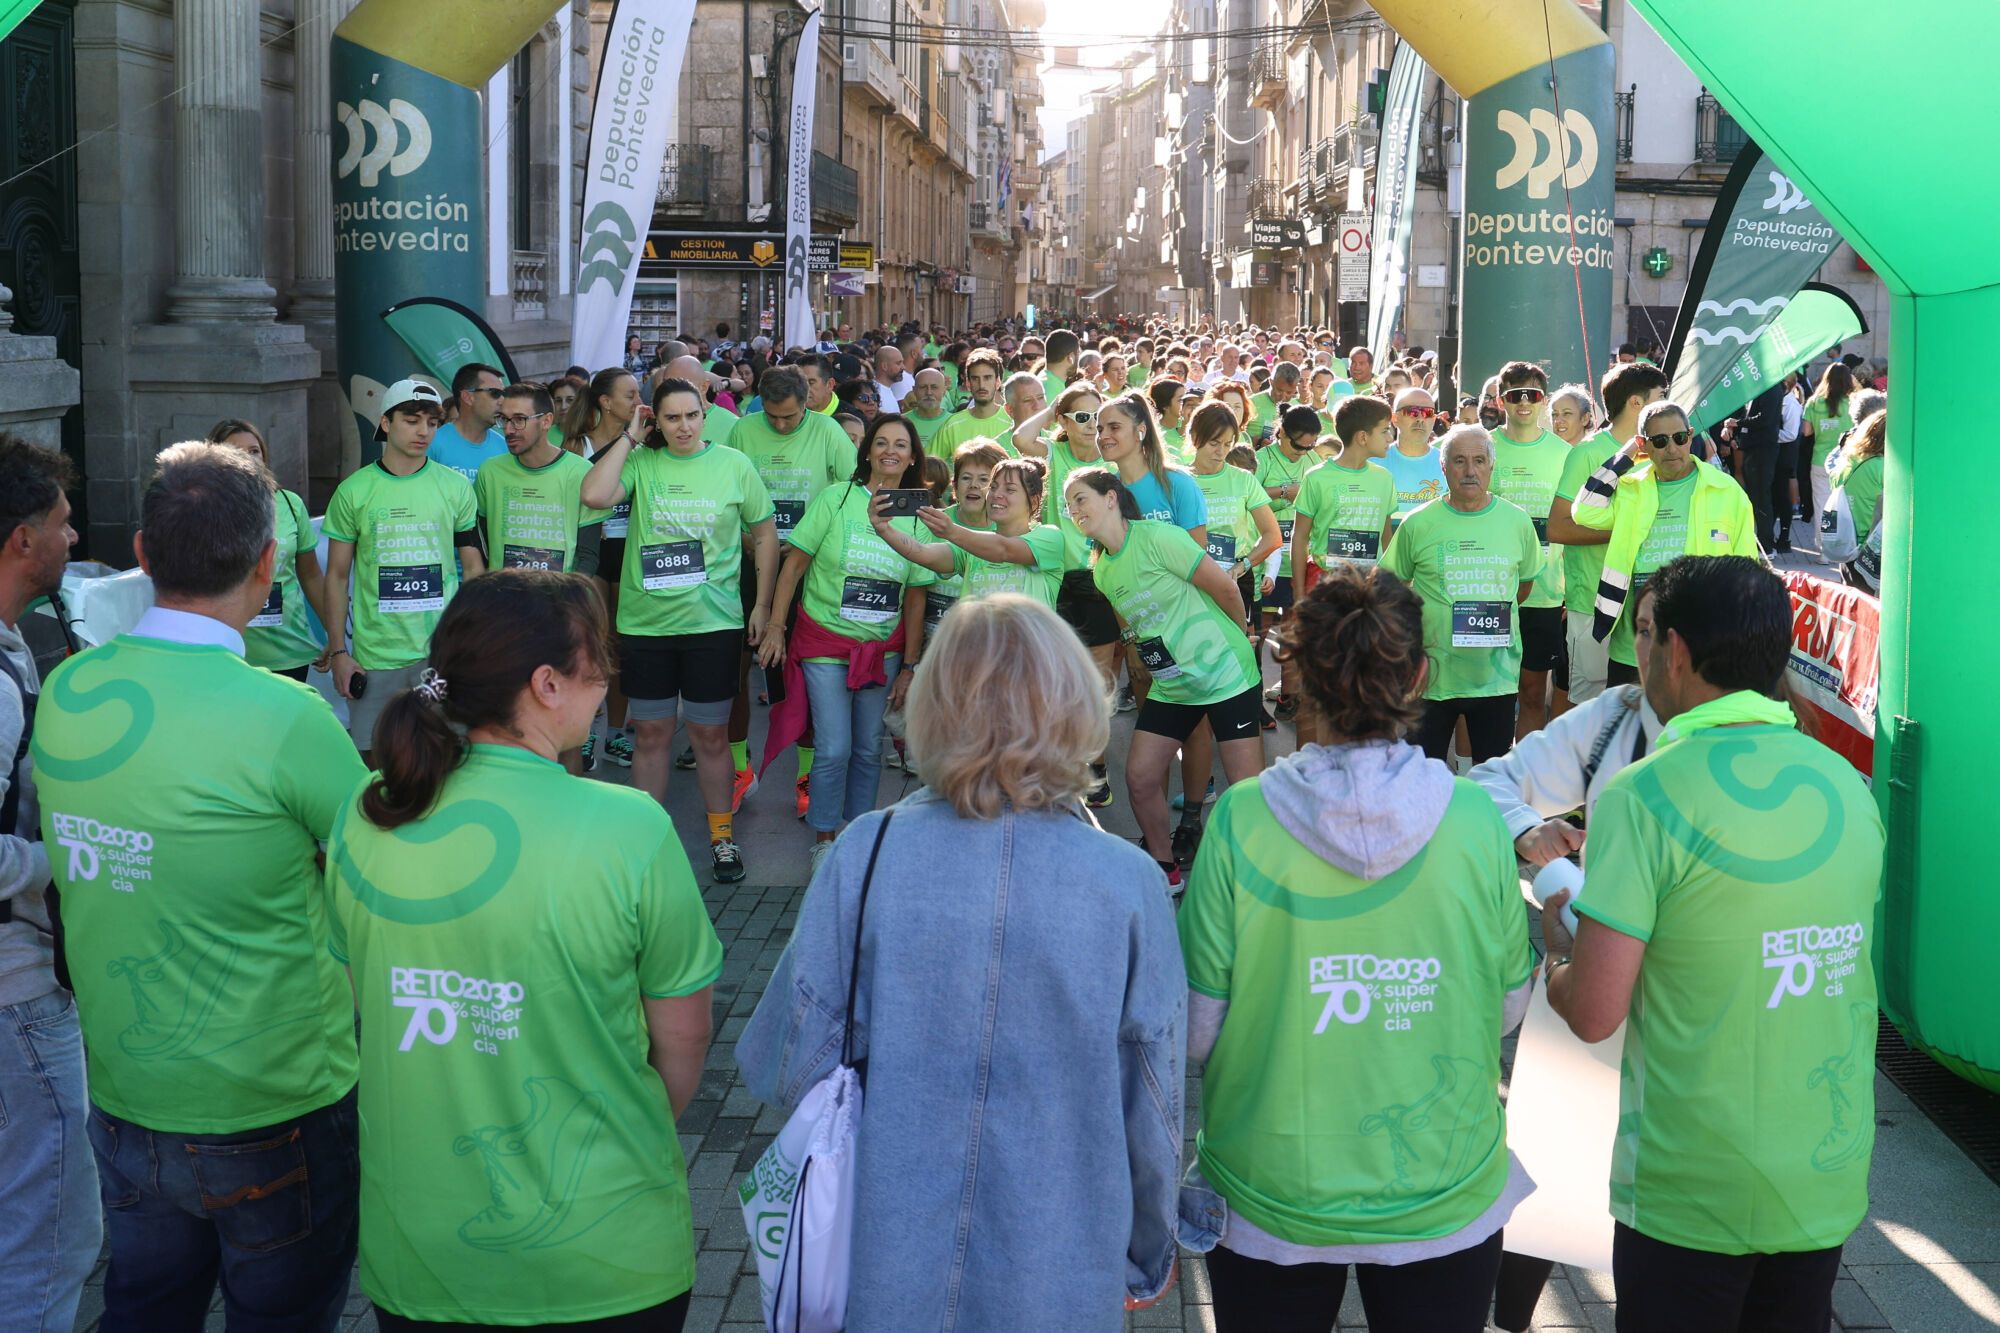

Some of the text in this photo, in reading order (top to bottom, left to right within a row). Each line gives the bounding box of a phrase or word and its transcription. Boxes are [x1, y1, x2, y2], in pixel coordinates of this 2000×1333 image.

[600, 17, 646, 183] Deputación
[618, 27, 665, 189] Pontevedra
[793, 104, 802, 222] Deputación
[798, 106, 807, 224] Pontevedra
[334, 194, 468, 228] eputación
[1255, 224, 1281, 233] Viajes
[1467, 208, 1614, 242] Deputación
[1736, 218, 1833, 239] Deputación
[681, 240, 725, 249] GESTION
[1254, 233, 1280, 242] Deza
[1733, 232, 1828, 254] Pontevedra
[670, 250, 738, 259] INMOBILIARIA
[1466, 240, 1613, 269] Pontevedra
[508, 500, 522, 510] En
[655, 495, 716, 508] En marcha
[653, 511, 715, 522] contra o
[1339, 506, 1372, 515] contra
[376, 520, 440, 533] En marcha
[508, 514, 552, 526] contra
[508, 527, 564, 540] cancro
[850, 534, 864, 545] En
[377, 535, 439, 549] contra o
[1341, 542, 1367, 552] 1981
[379, 550, 441, 563] cancro
[656, 554, 690, 568] 0888
[847, 549, 894, 566] contra
[1445, 555, 1508, 565] En marcha
[1643, 551, 1683, 562] canc
[516, 561, 548, 570] 2488
[973, 573, 984, 582] En
[1445, 568, 1508, 580] contra o
[394, 581, 428, 593] 2403
[1447, 583, 1506, 596] cancro
[857, 592, 887, 605] 2274
[1149, 602, 1158, 610] o
[1468, 616, 1500, 628] 0495
[1144, 651, 1162, 665] 1398
[52, 812, 154, 853] RETO2030
[108, 848, 153, 866] super
[109, 863, 152, 880] viven
[112, 877, 134, 892] cia
[1762, 922, 1864, 958] RETO2030
[1825, 947, 1861, 965] super
[1309, 954, 1441, 984] RETO2030
[1825, 963, 1855, 980] viven
[391, 966, 525, 1010] RETO2030
[1384, 983, 1438, 1000] super
[1824, 981, 1844, 997] cia
[1384, 998, 1433, 1014] viven
[470, 1004, 523, 1024] super
[472, 1020, 518, 1040] viven
[1384, 1016, 1411, 1031] cia
[474, 1037, 498, 1056] cia
